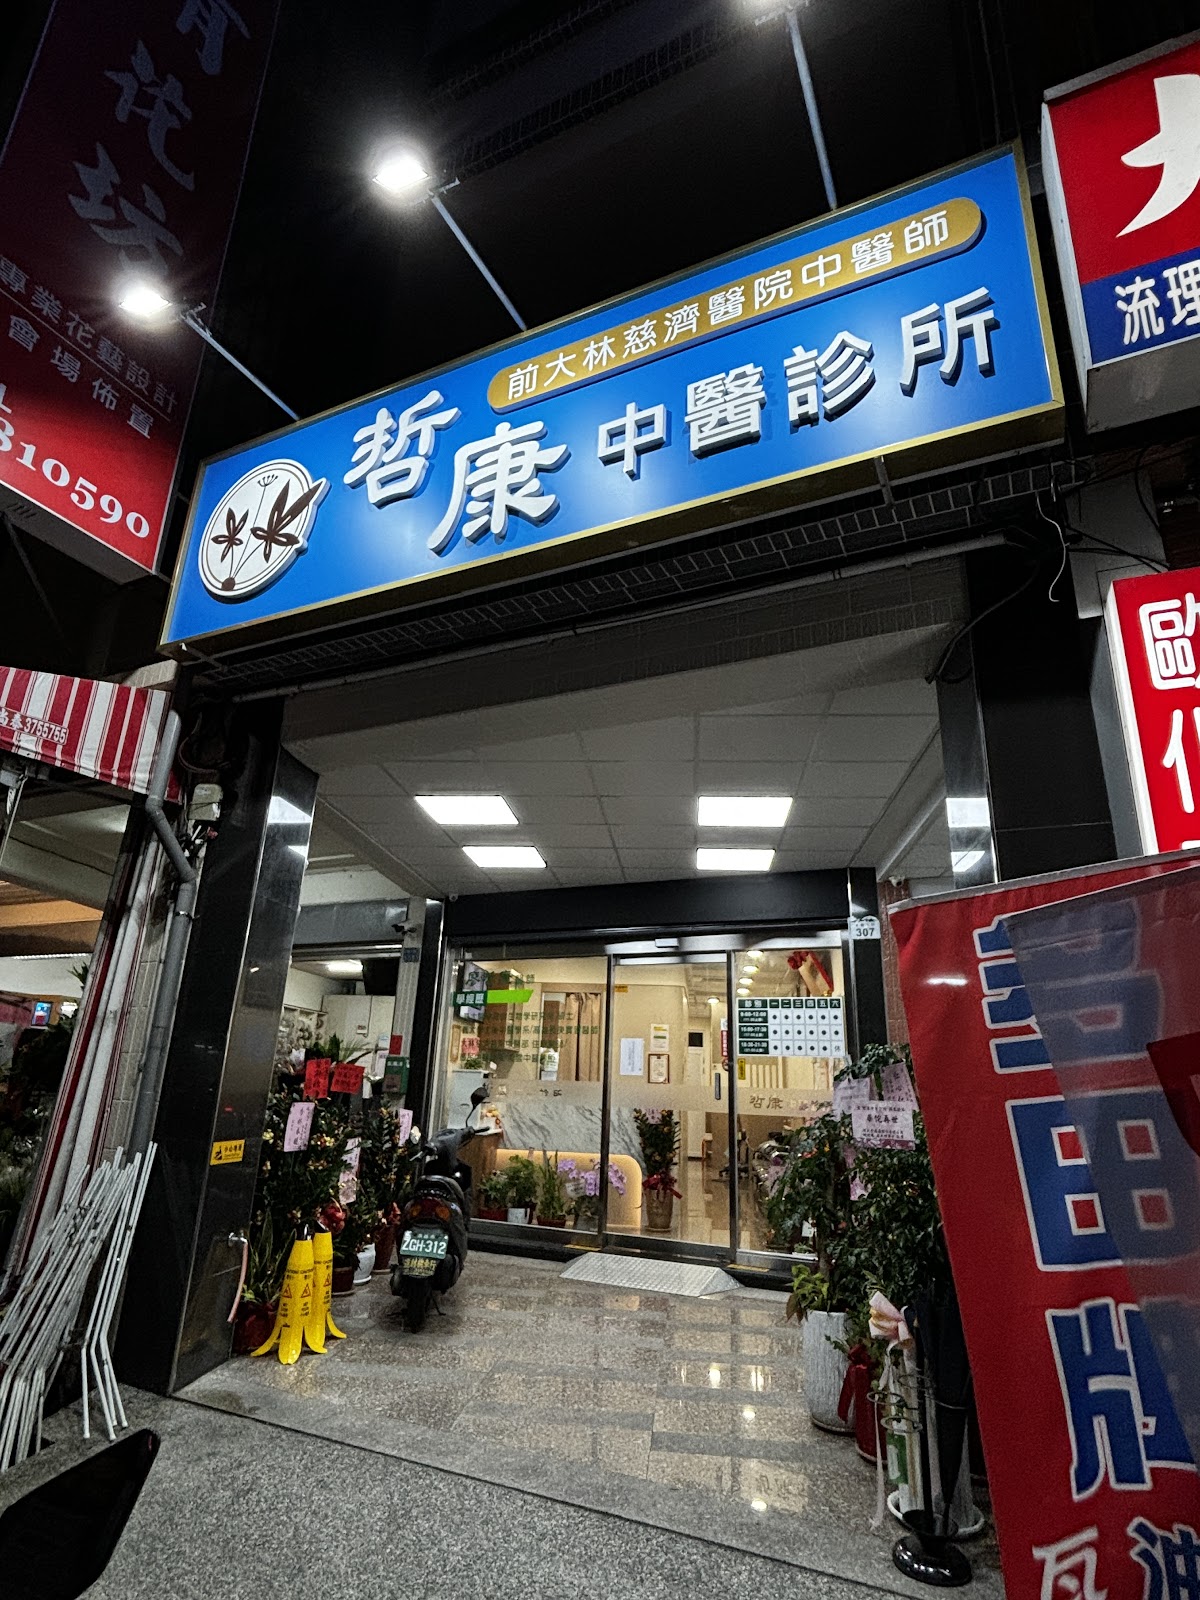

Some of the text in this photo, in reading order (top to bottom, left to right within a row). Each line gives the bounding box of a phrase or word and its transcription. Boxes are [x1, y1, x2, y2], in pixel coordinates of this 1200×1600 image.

[0, 256, 179, 417] 專業花藝設計
[507, 208, 950, 402] 前大林慈濟醫院中醫師
[8, 314, 155, 440] 會場佈置
[344, 286, 1000, 556] 哲康中醫診所
[855, 927, 875, 937] 307
[401, 1237, 447, 1255] ZGH-312
